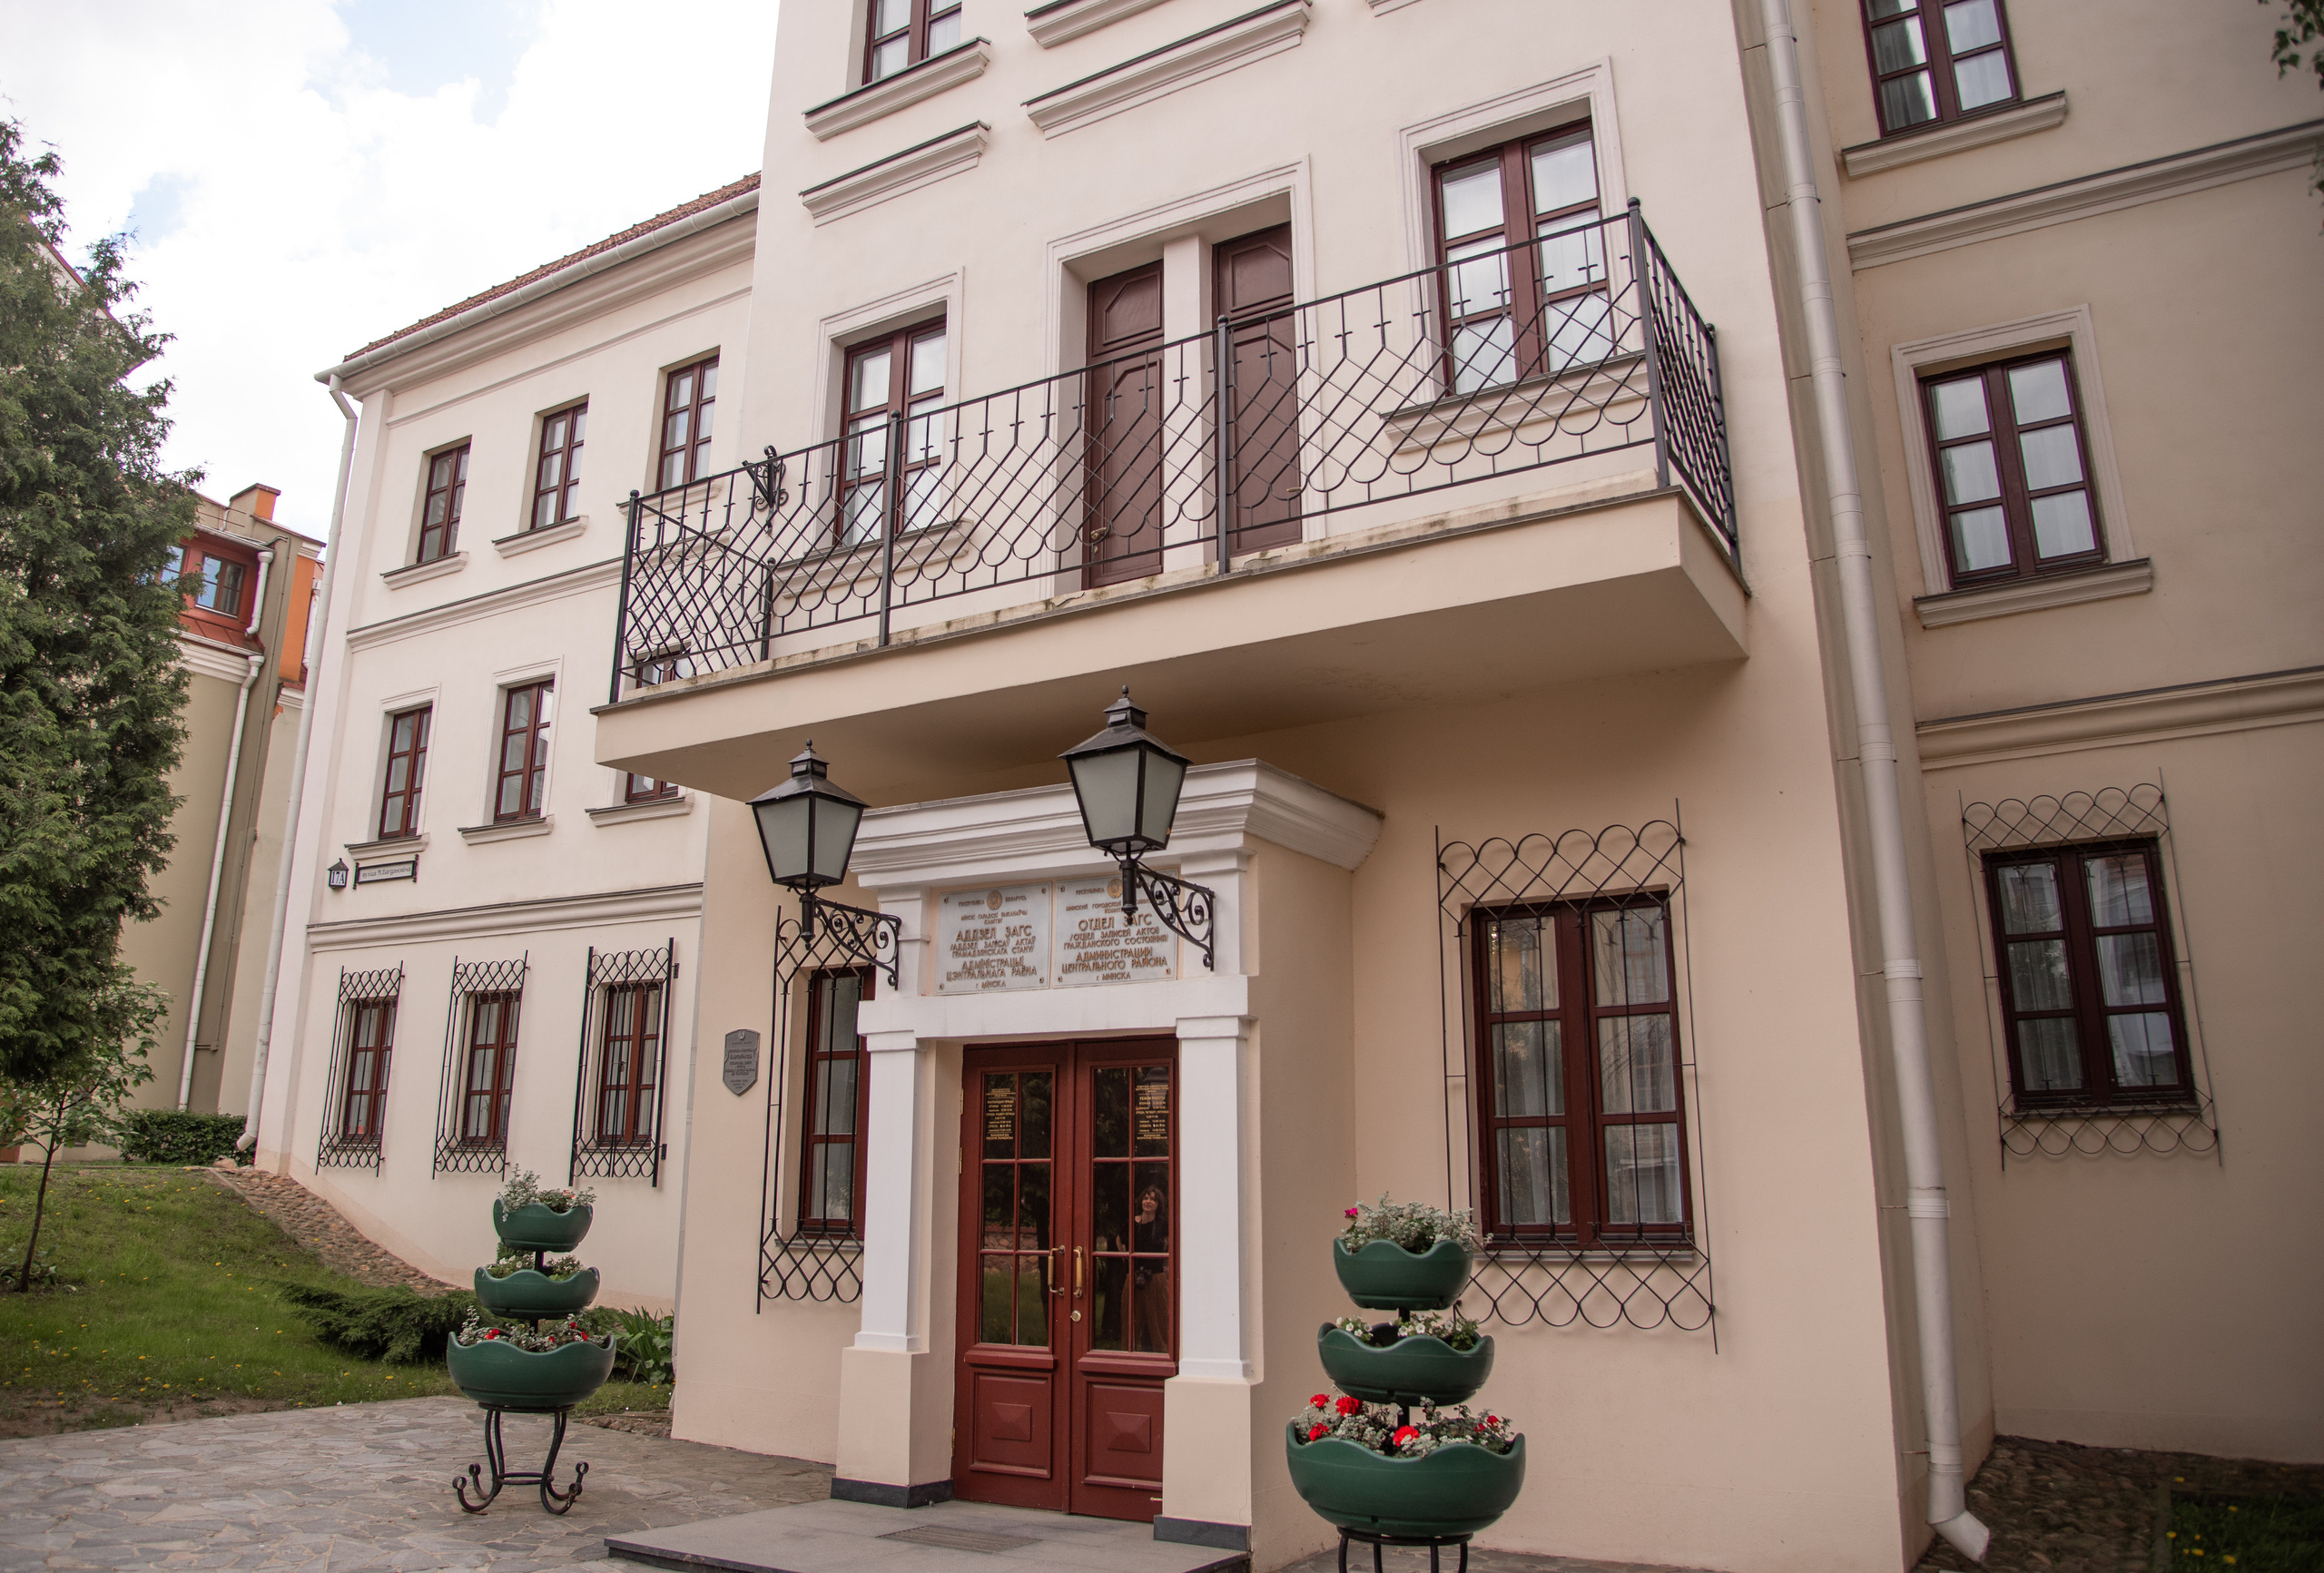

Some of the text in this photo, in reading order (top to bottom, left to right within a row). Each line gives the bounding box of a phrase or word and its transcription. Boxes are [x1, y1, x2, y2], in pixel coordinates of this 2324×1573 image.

[1092, 900, 1121, 909] ГОРОДСКОЙ
[1078, 916, 1114, 931] ОТДЕЛ
[956, 924, 1032, 942] АДДЗЕЛ ЗАГС
[1100, 928, 1130, 939] ЗАПИСЕЙ
[1136, 927, 1159, 936] АКТОВ
[1063, 939, 1120, 950] ГРАЖДАНСКОГО
[1076, 947, 1153, 962] АДМИНИСТРАЦИИ
[1061, 956, 1167, 974] ЦЕНТРАЛЬНОГО РАЙОНА
[946, 966, 1037, 982] ЦЭНТРАЛЬНАГА РАЁНА
[1101, 972, 1131, 981] МИНСКА
